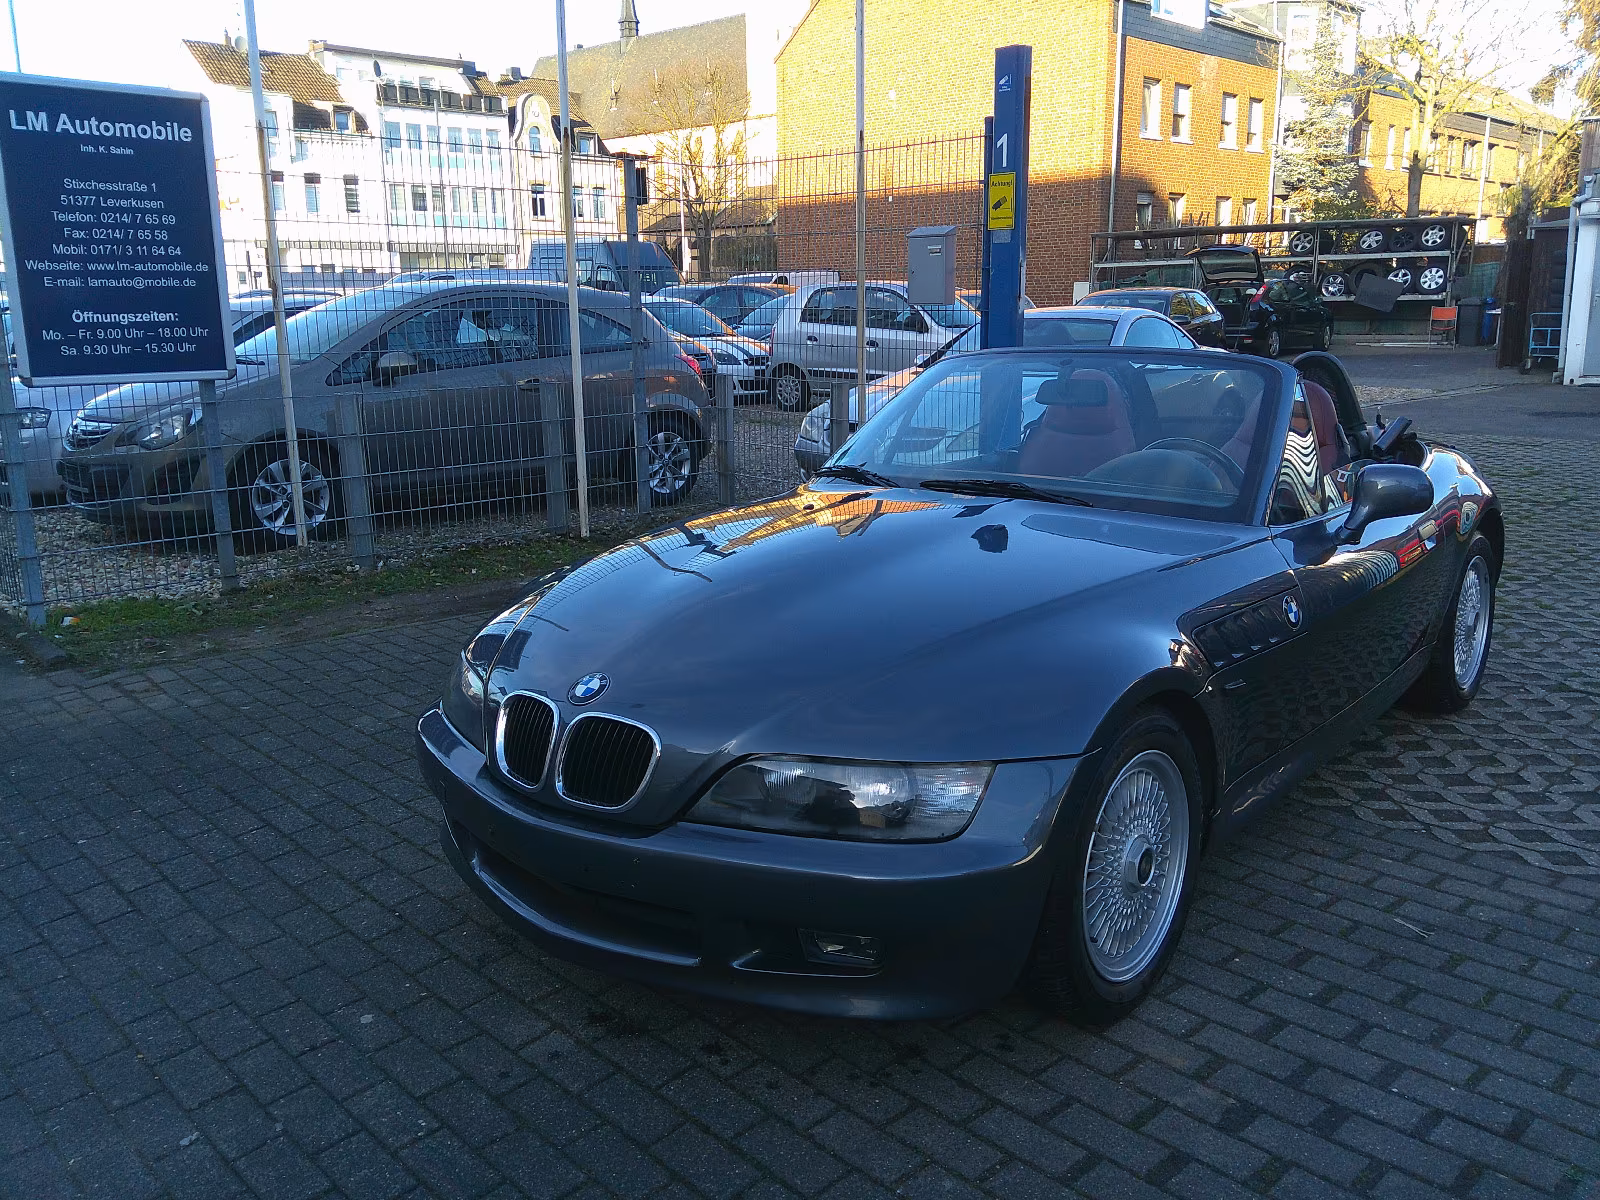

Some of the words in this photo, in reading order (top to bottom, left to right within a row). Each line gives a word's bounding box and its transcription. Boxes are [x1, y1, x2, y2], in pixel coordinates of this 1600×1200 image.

[9, 110, 48, 131] LM
[56, 114, 192, 141] Automobile
[81, 144, 96, 152] Inh.
[110, 146, 134, 155] Sahin
[996, 133, 1007, 167] 1
[64, 178, 147, 191] Stixchesstraße
[151, 183, 156, 193] 1
[61, 195, 96, 205] 51377
[100, 197, 164, 208] Leverkusen
[53, 211, 96, 222] Telefon:
[101, 213, 131, 223] 0214/
[135, 214, 141, 223] 7
[145, 214, 159, 224] 65
[162, 215, 175, 224] 69
[64, 228, 89, 238] Fax:
[93, 229, 123, 239] 0214/
[128, 230, 133, 239] 7
[138, 230, 151, 239] 65
[155, 230, 167, 240] 58
[53, 244, 87, 254] Mobil:
[91, 245, 122, 255] 0171/
[126, 245, 132, 255] 3
[137, 246, 147, 255] 11
[152, 246, 165, 255] 64
[168, 246, 181, 255] 64
[25, 260, 83, 270] Webseite:
[87, 261, 208, 271] www.lm-automobile.de
[44, 277, 84, 286] E-mail:
[88, 277, 196, 288] lamauto@mobile.de
[72, 310, 178, 324] Öffnungszeiten:
[43, 330, 64, 340] Mo.
[79, 330, 93, 339] Fr.
[97, 329, 121, 338] 9.00
[125, 329, 144, 338] Uhr
[158, 328, 186, 337] 18.00
[190, 327, 208, 336] Uhr
[61, 346, 79, 355] Sa.
[84, 345, 107, 354] 9.30
[112, 345, 131, 354] Uhr
[145, 343, 174, 352] 15.30
[178, 343, 196, 352] Uhr
